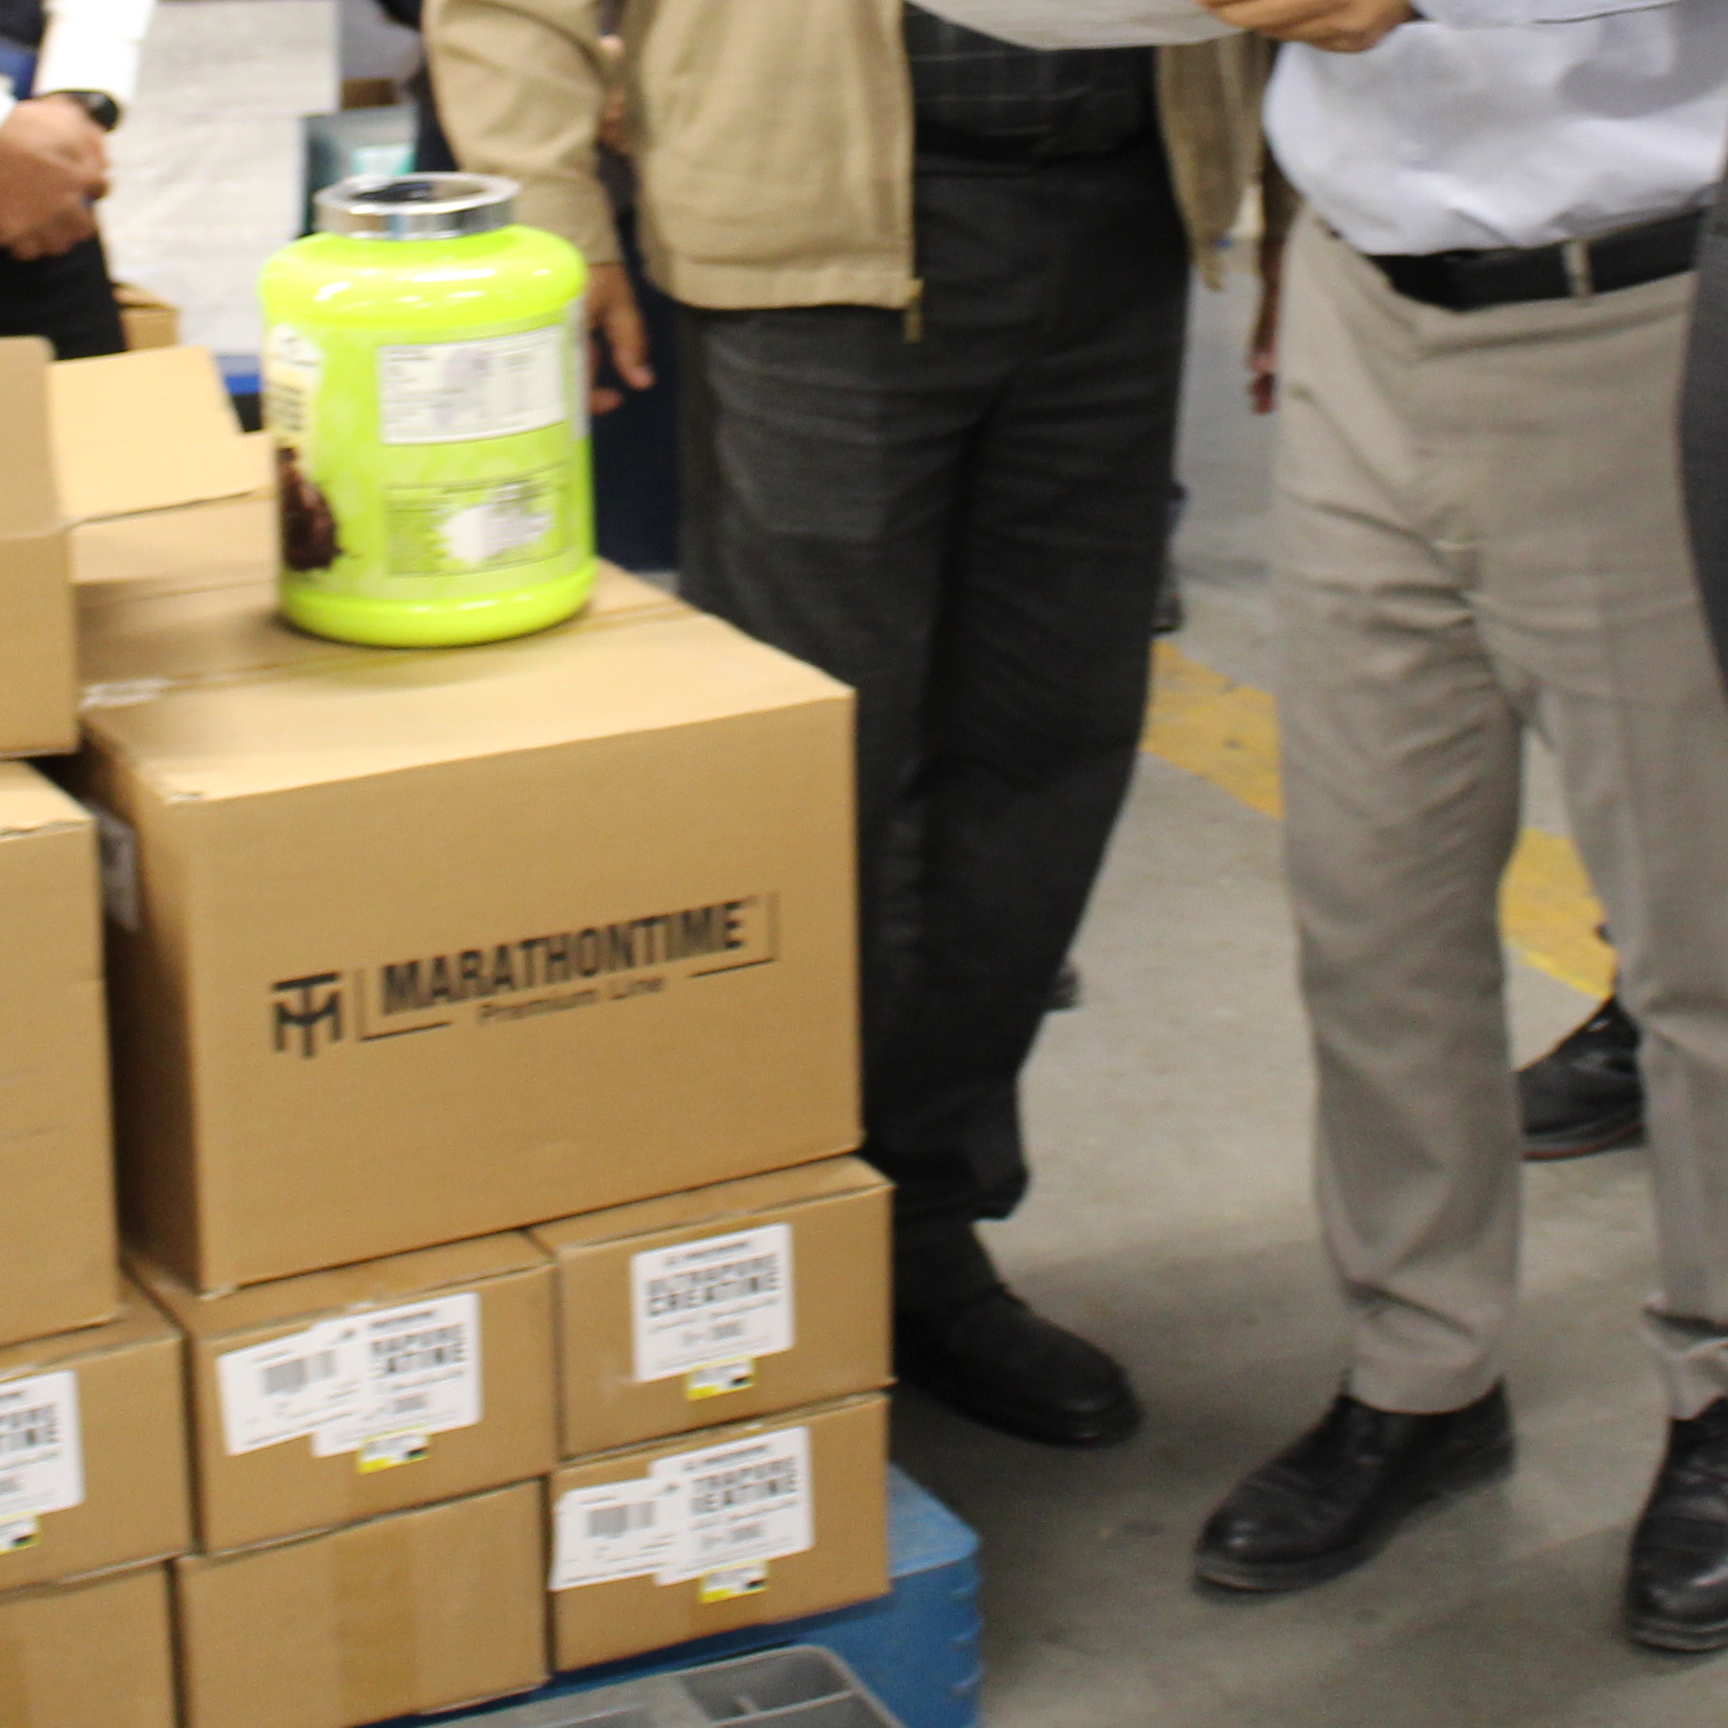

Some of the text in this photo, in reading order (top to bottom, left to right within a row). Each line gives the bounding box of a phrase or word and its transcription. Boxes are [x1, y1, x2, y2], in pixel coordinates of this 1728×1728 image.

[381, 896, 749, 1016] MARATHONTIME
[476, 975, 668, 1025] Premium Line
